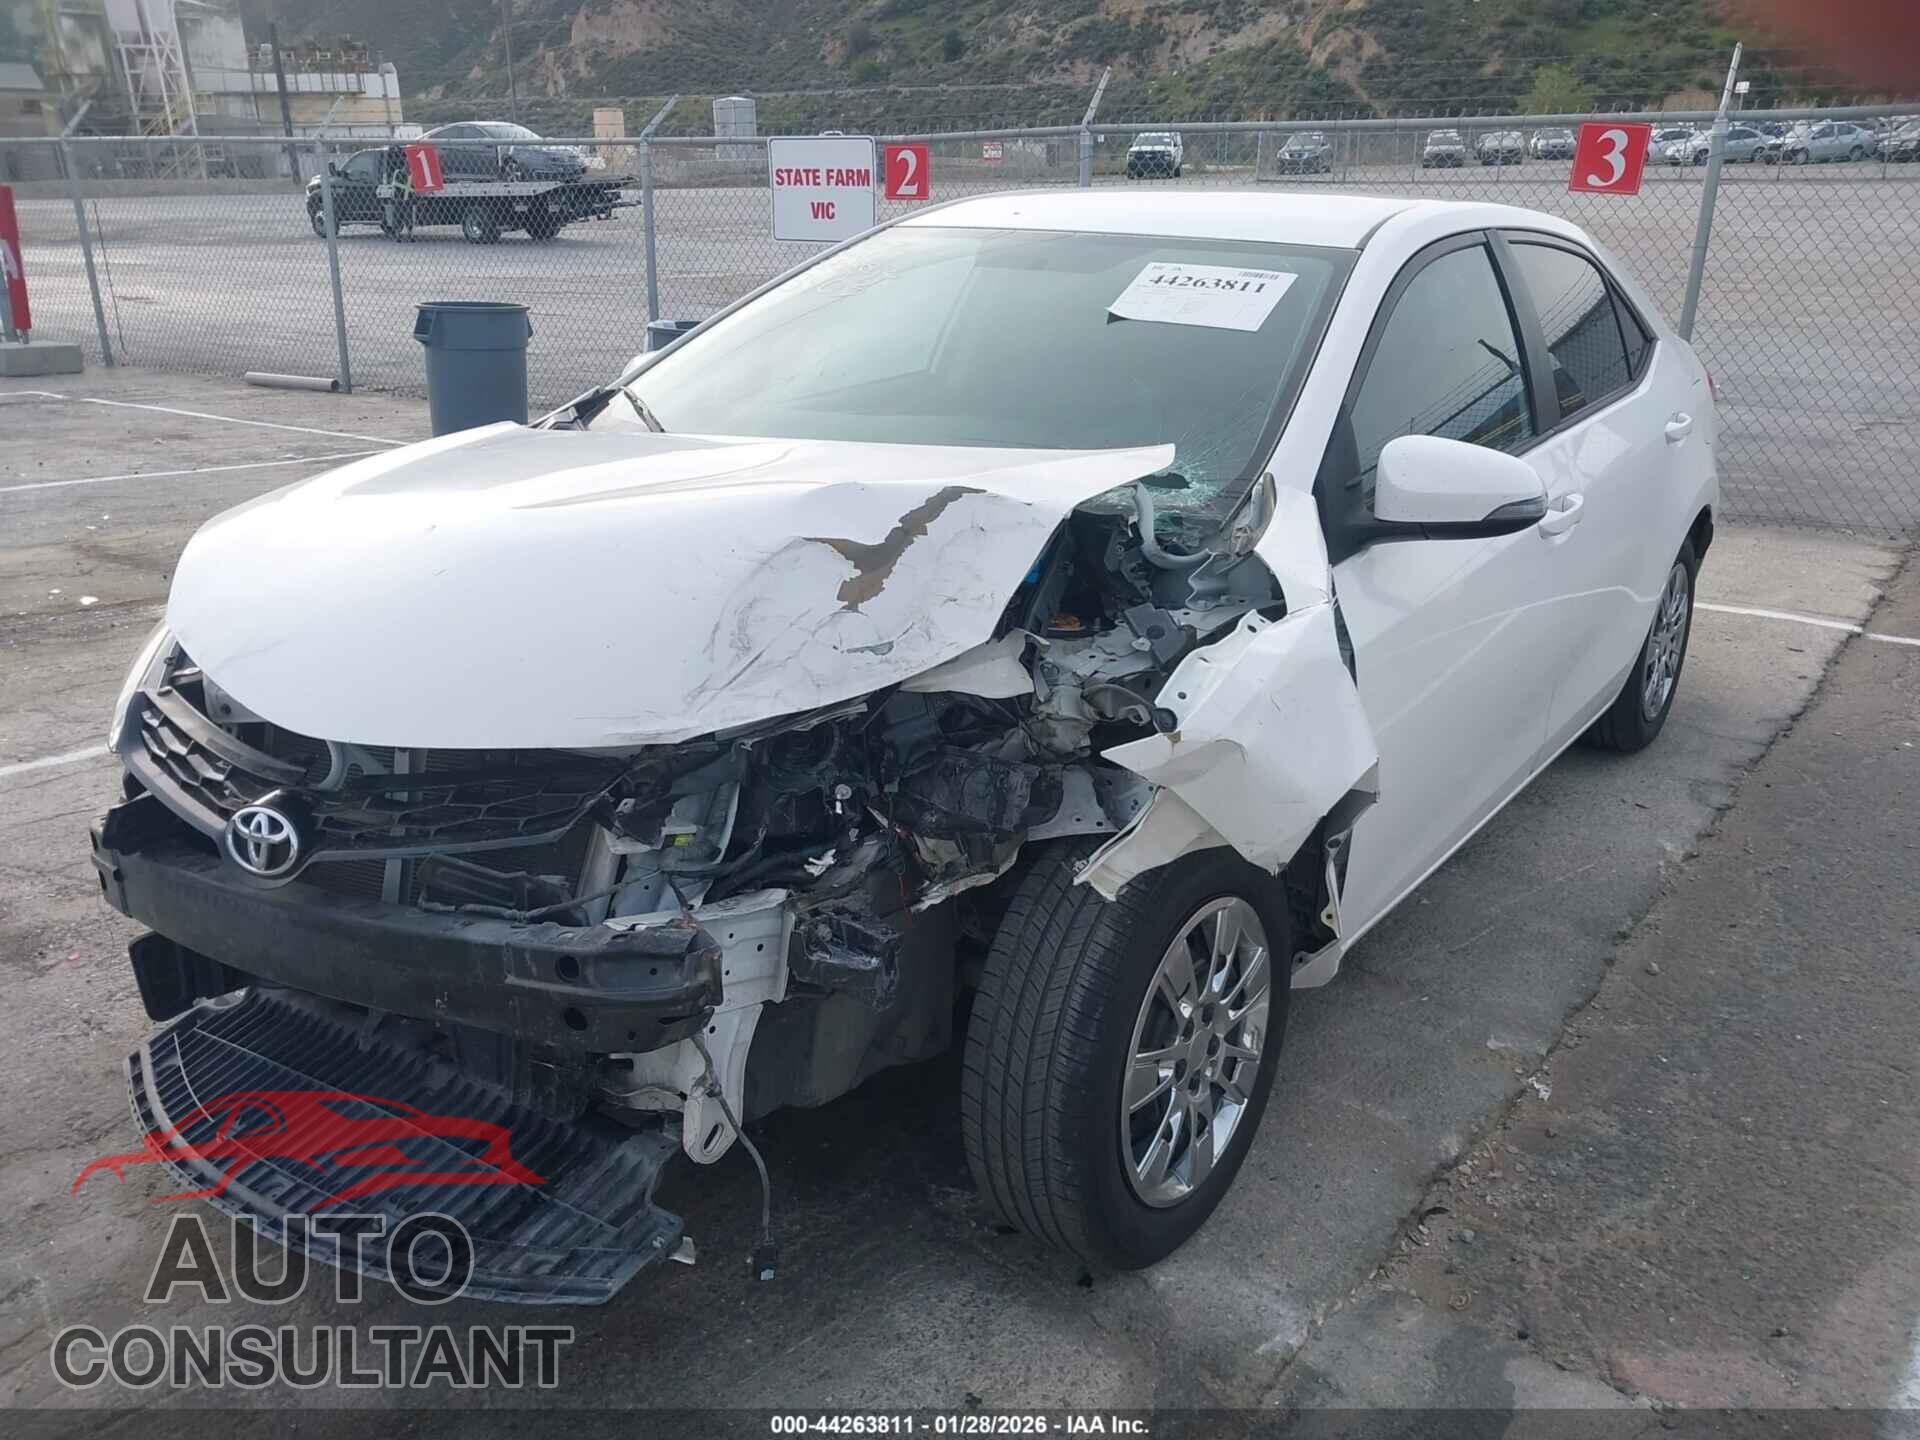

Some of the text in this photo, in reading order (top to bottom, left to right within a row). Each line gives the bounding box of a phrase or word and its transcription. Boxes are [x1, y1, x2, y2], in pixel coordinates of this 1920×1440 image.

[415, 150, 436, 188] 1
[895, 149, 919, 196] 2
[1586, 129, 1629, 187] 3
[775, 168, 870, 187] STATE FARM
[810, 201, 836, 220] VIC
[1149, 274, 1267, 294] 44263811
